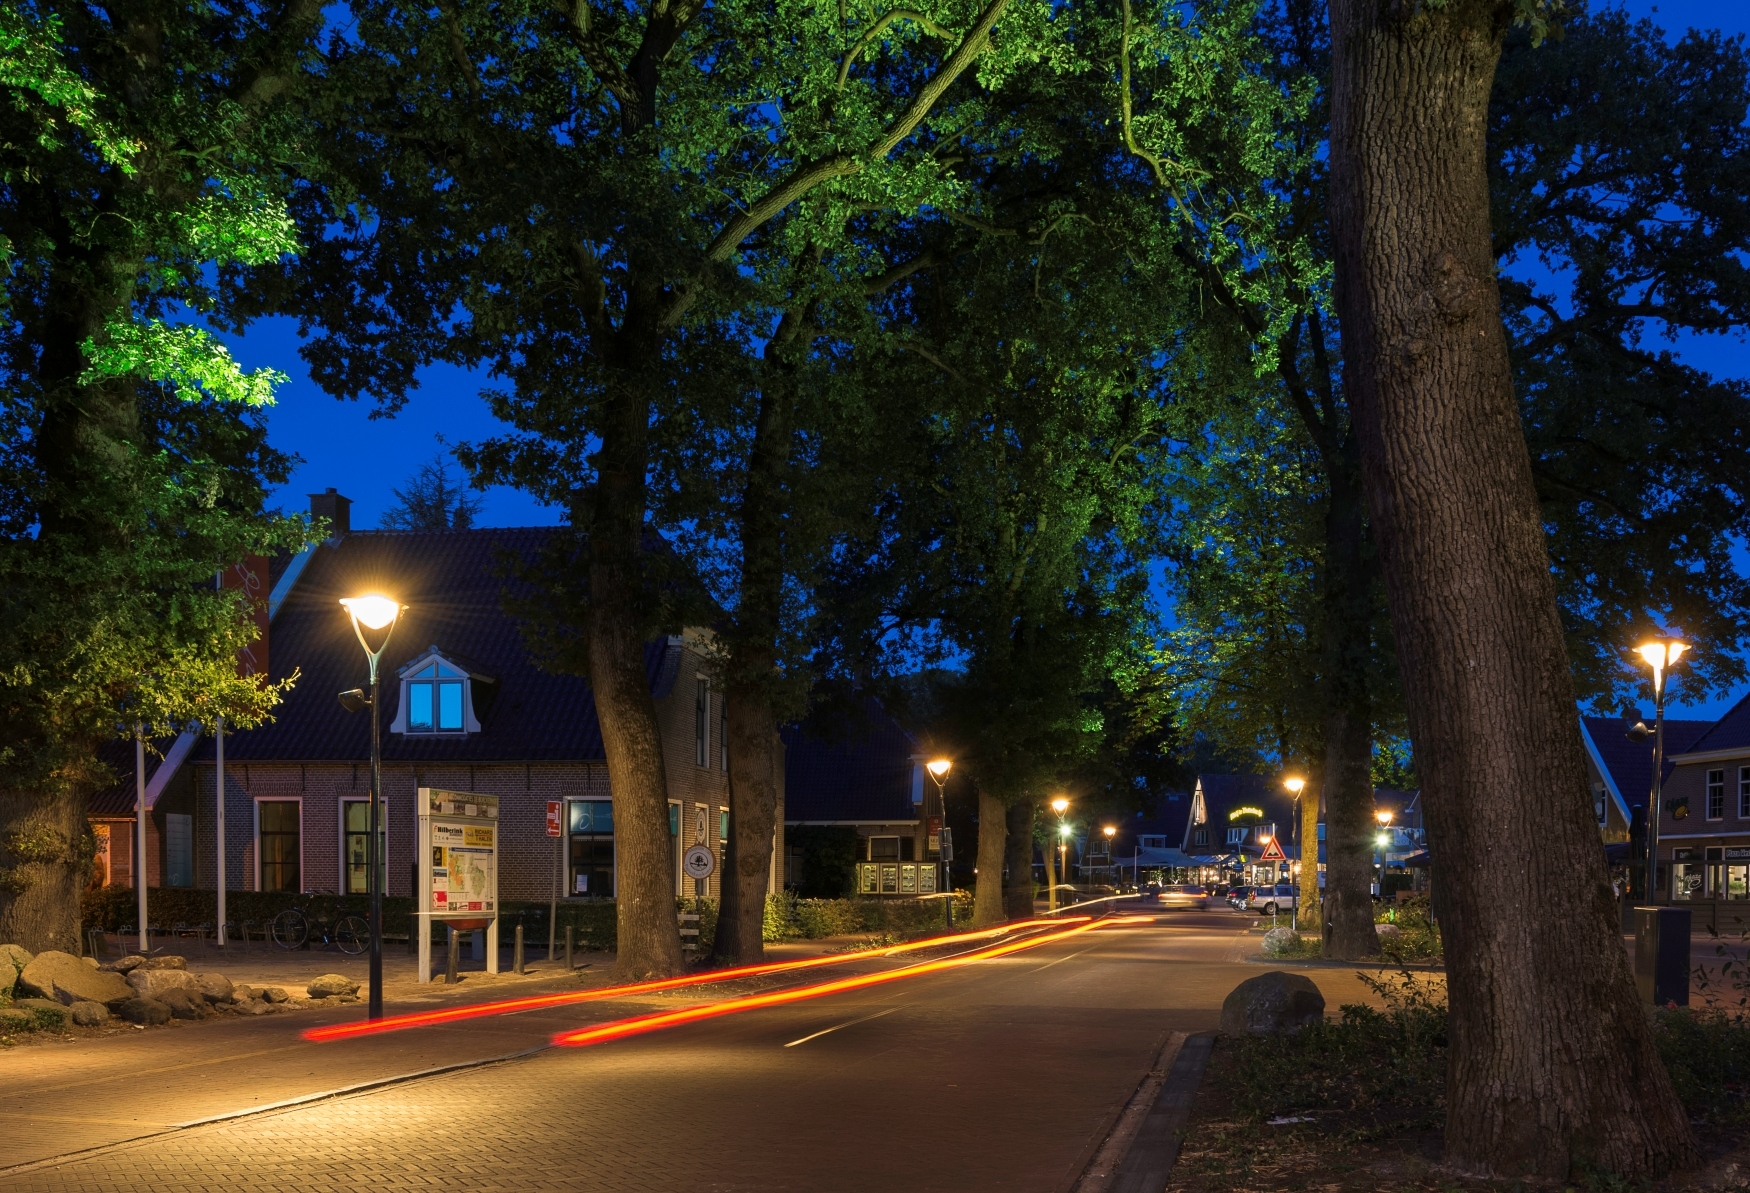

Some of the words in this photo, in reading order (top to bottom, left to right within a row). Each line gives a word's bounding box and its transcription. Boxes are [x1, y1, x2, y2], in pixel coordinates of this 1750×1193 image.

[438, 826, 463, 834] Hilberink
[475, 828, 493, 836] RICHARD
[1726, 849, 1740, 858] Plaza
